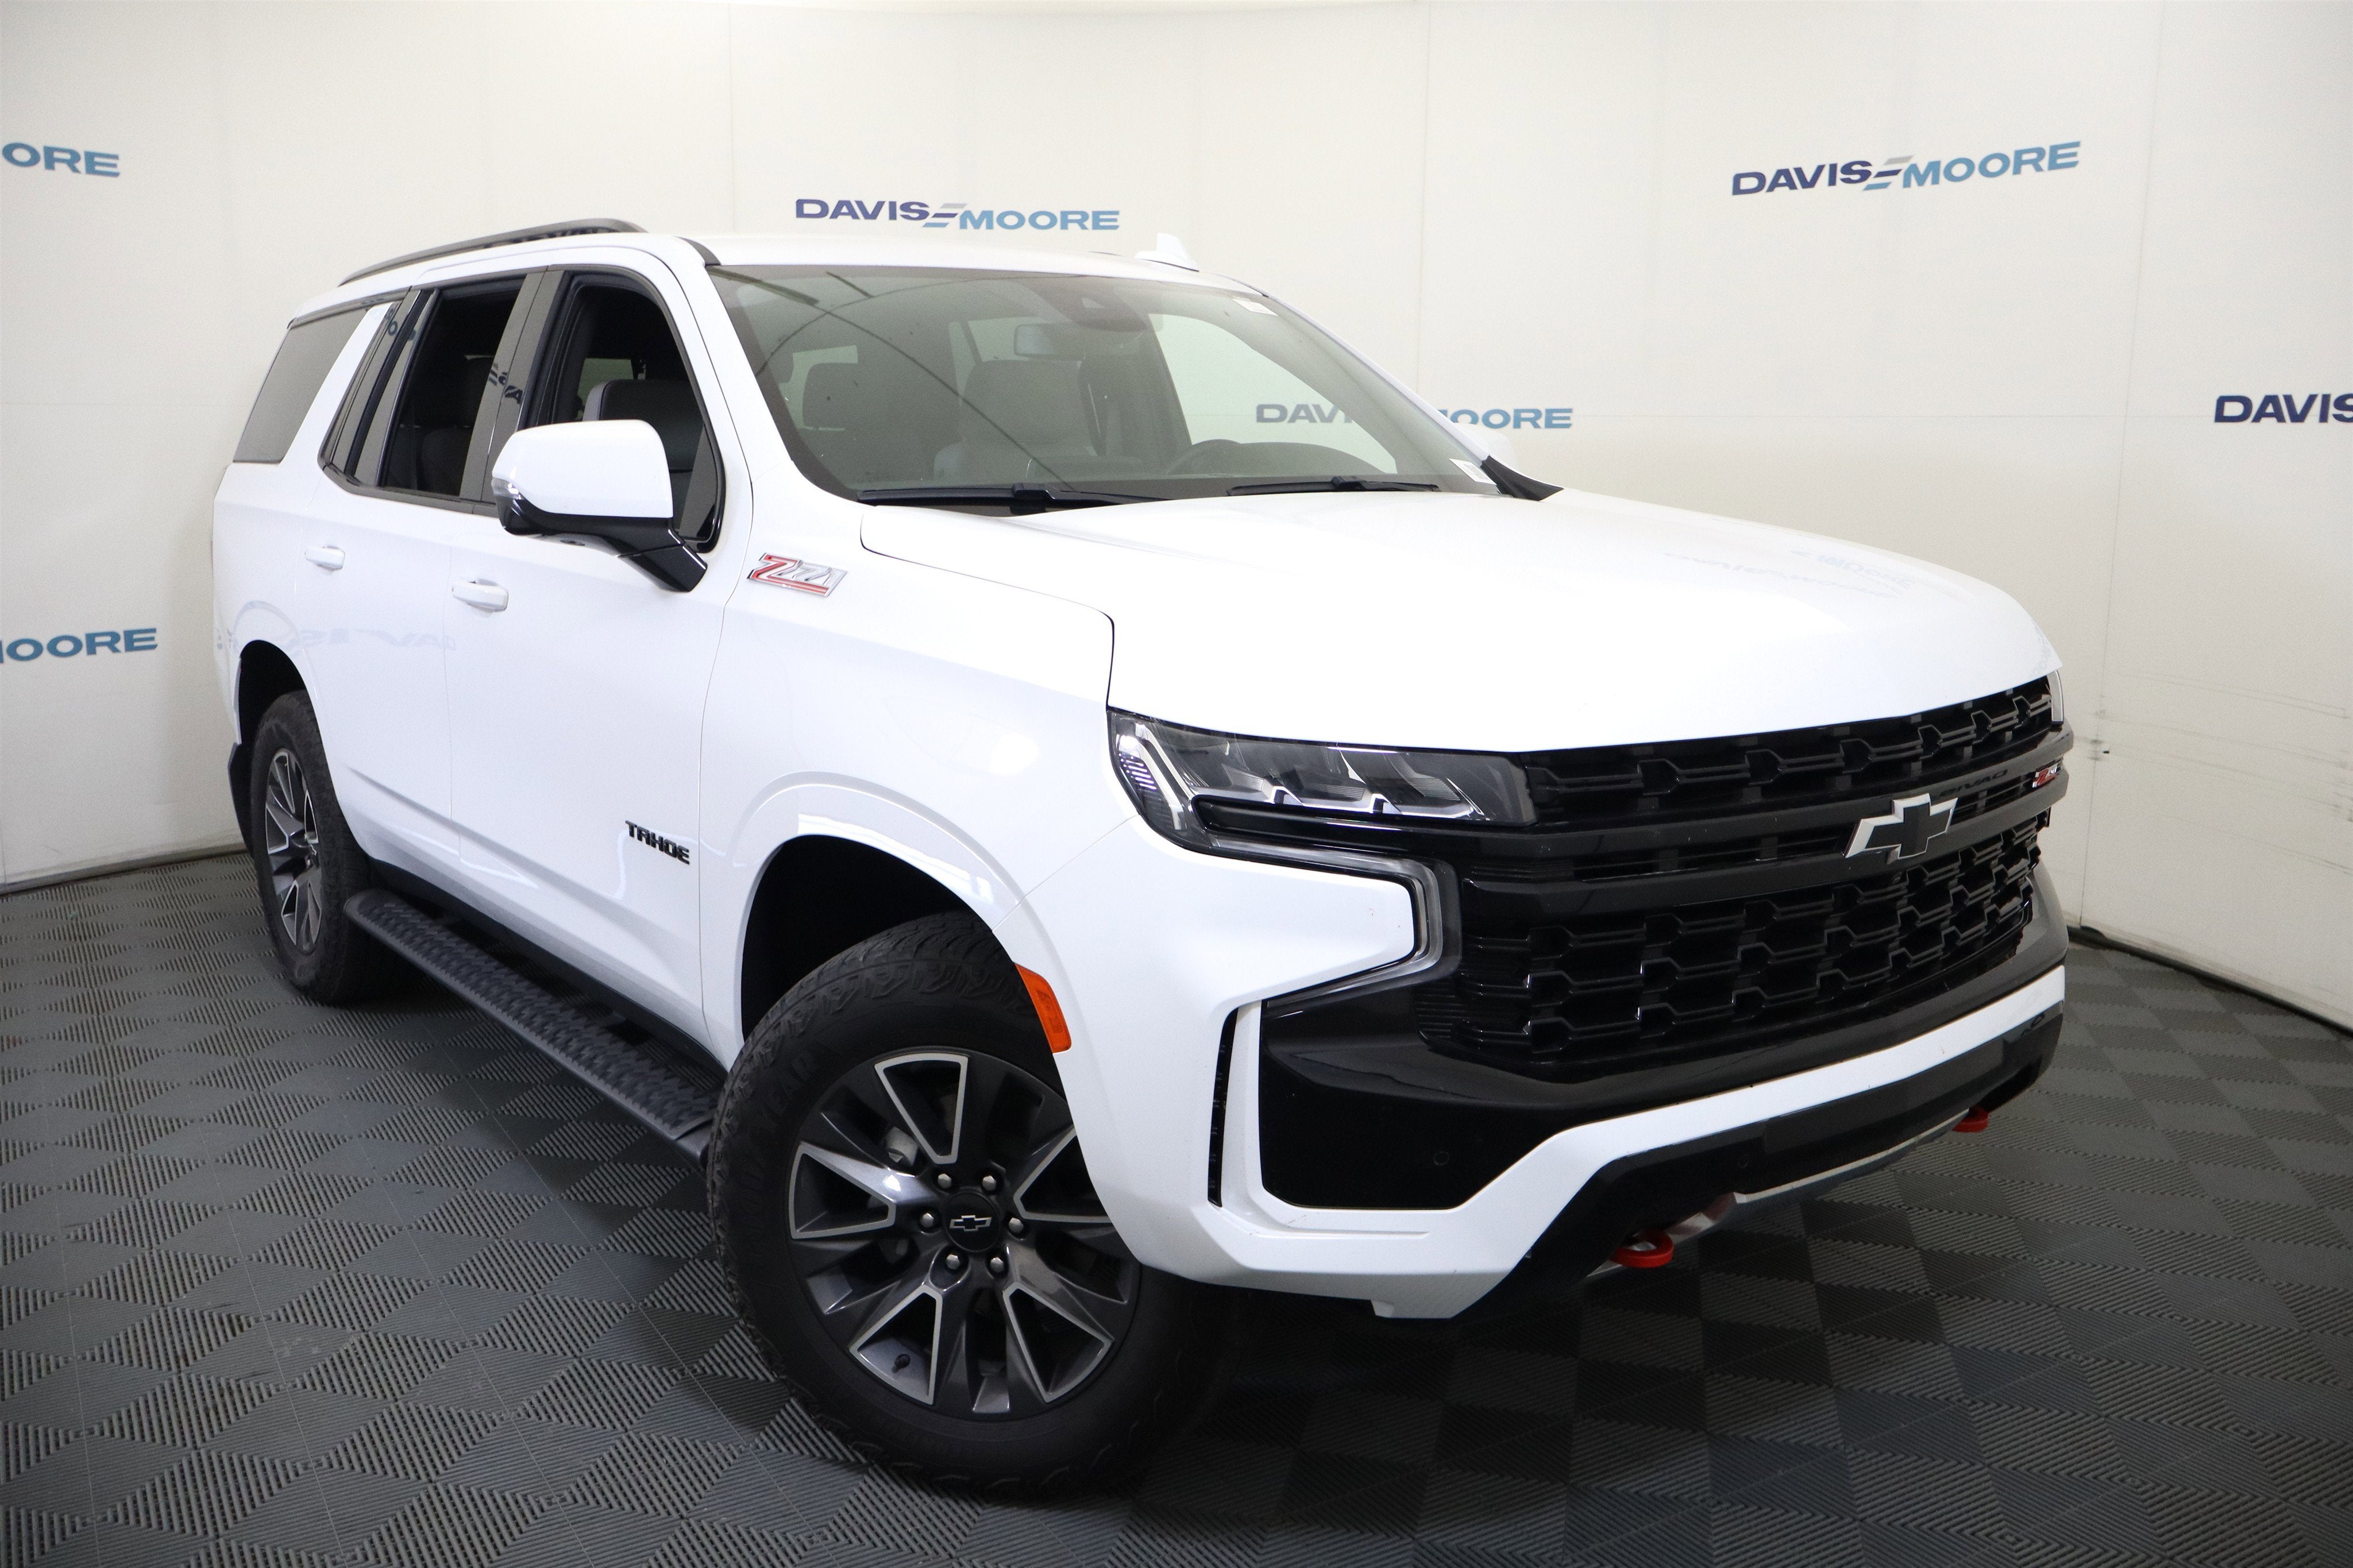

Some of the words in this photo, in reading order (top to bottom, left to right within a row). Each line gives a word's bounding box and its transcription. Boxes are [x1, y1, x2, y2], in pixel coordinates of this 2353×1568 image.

[1731, 160, 1873, 196] DAVIS
[1902, 141, 2081, 188] MOORE
[795, 198, 929, 221] DAVIS
[959, 210, 1120, 230] MOORE
[1437, 408, 1573, 429] OORE
[2214, 393, 2353, 423] DAVIS
[747, 553, 848, 597] Z71
[0, 628, 158, 664] OORE
[625, 820, 690, 865] TAHOE
